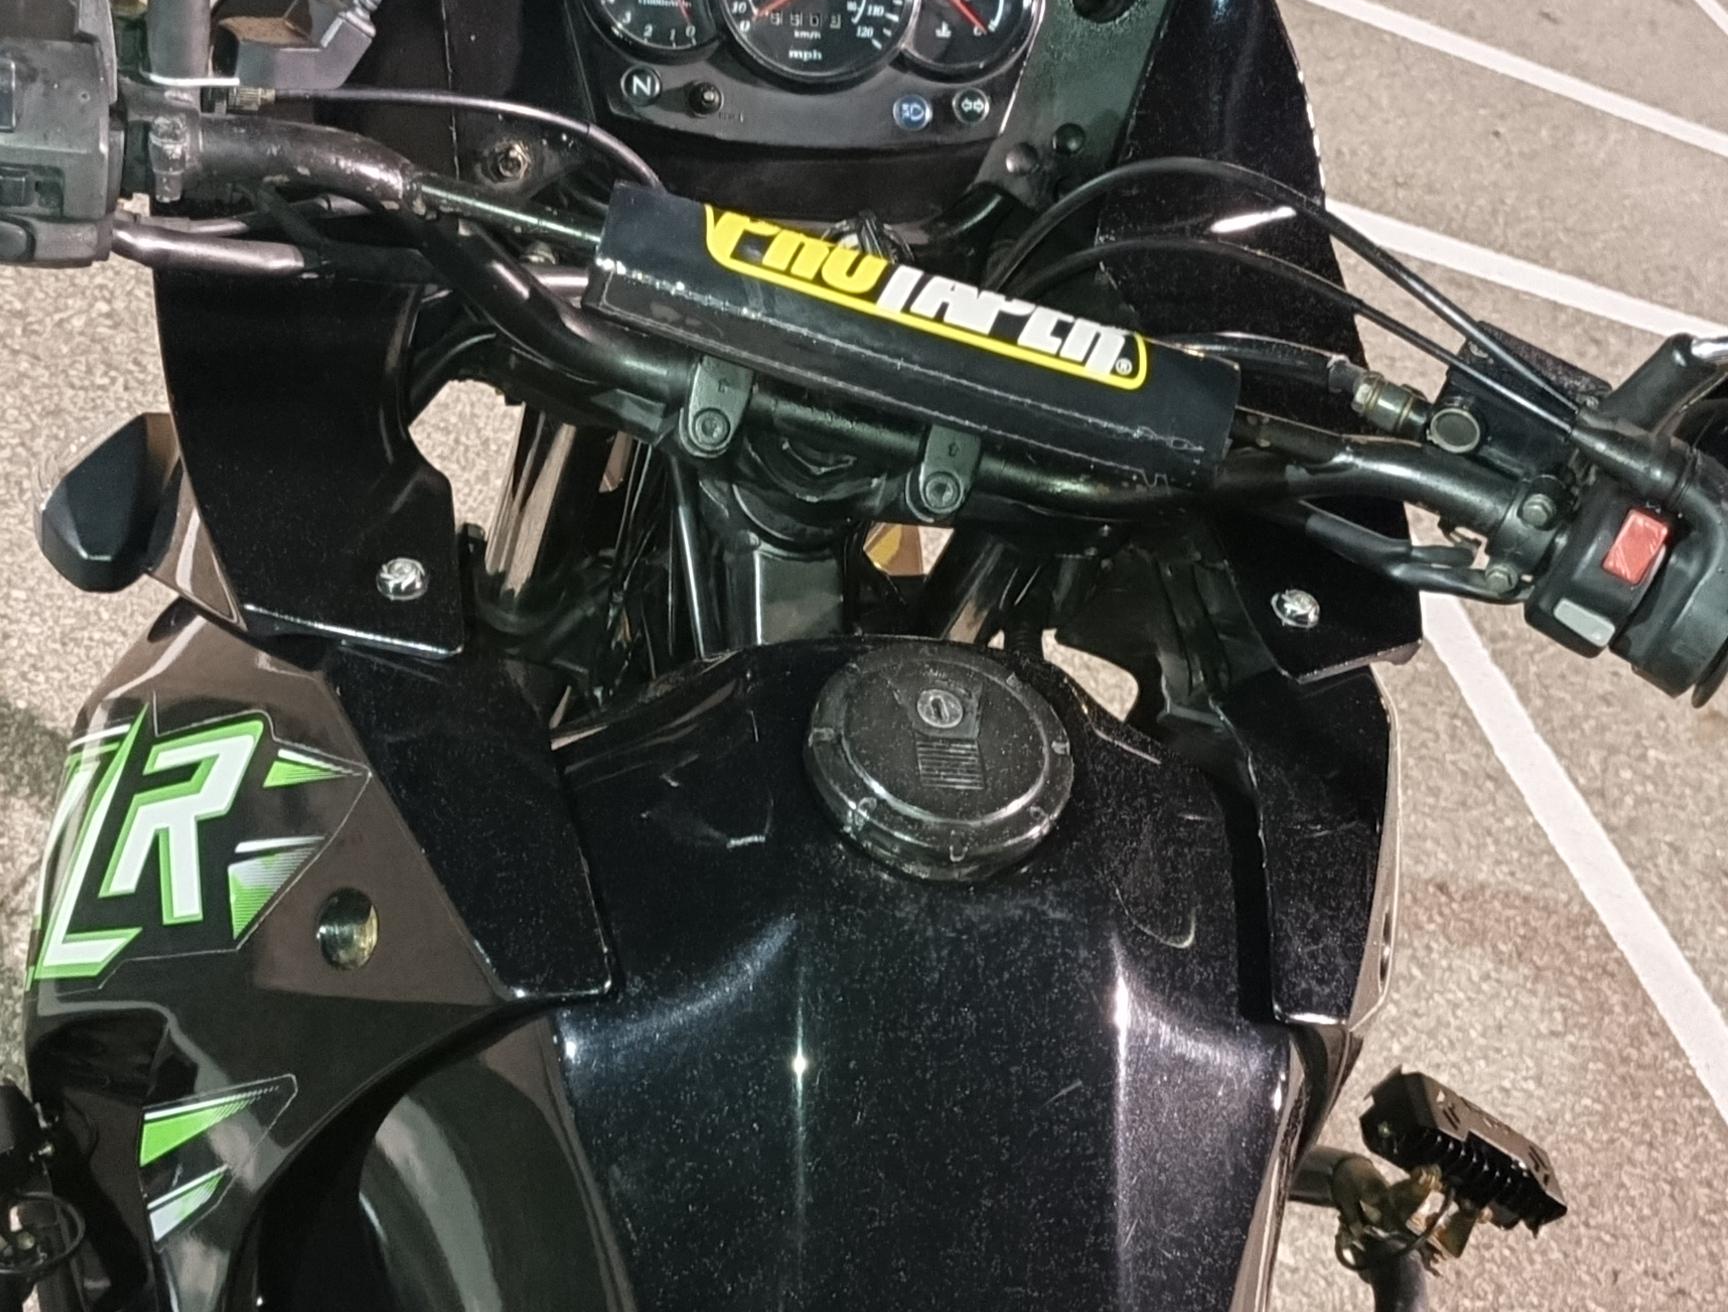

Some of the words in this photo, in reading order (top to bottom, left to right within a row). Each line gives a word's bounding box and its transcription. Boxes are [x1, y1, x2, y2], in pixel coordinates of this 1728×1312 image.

[731, 1, 747, 14] 10
[867, 4, 885, 17] 110
[622, 10, 632, 24] 3
[643, 24, 653, 38] 2
[685, 24, 696, 38] 0
[739, 20, 750, 33] 0
[856, 25, 874, 38] 120
[669, 28, 677, 41] 1
[788, 48, 823, 62] mph
[632, 75, 651, 97] N
